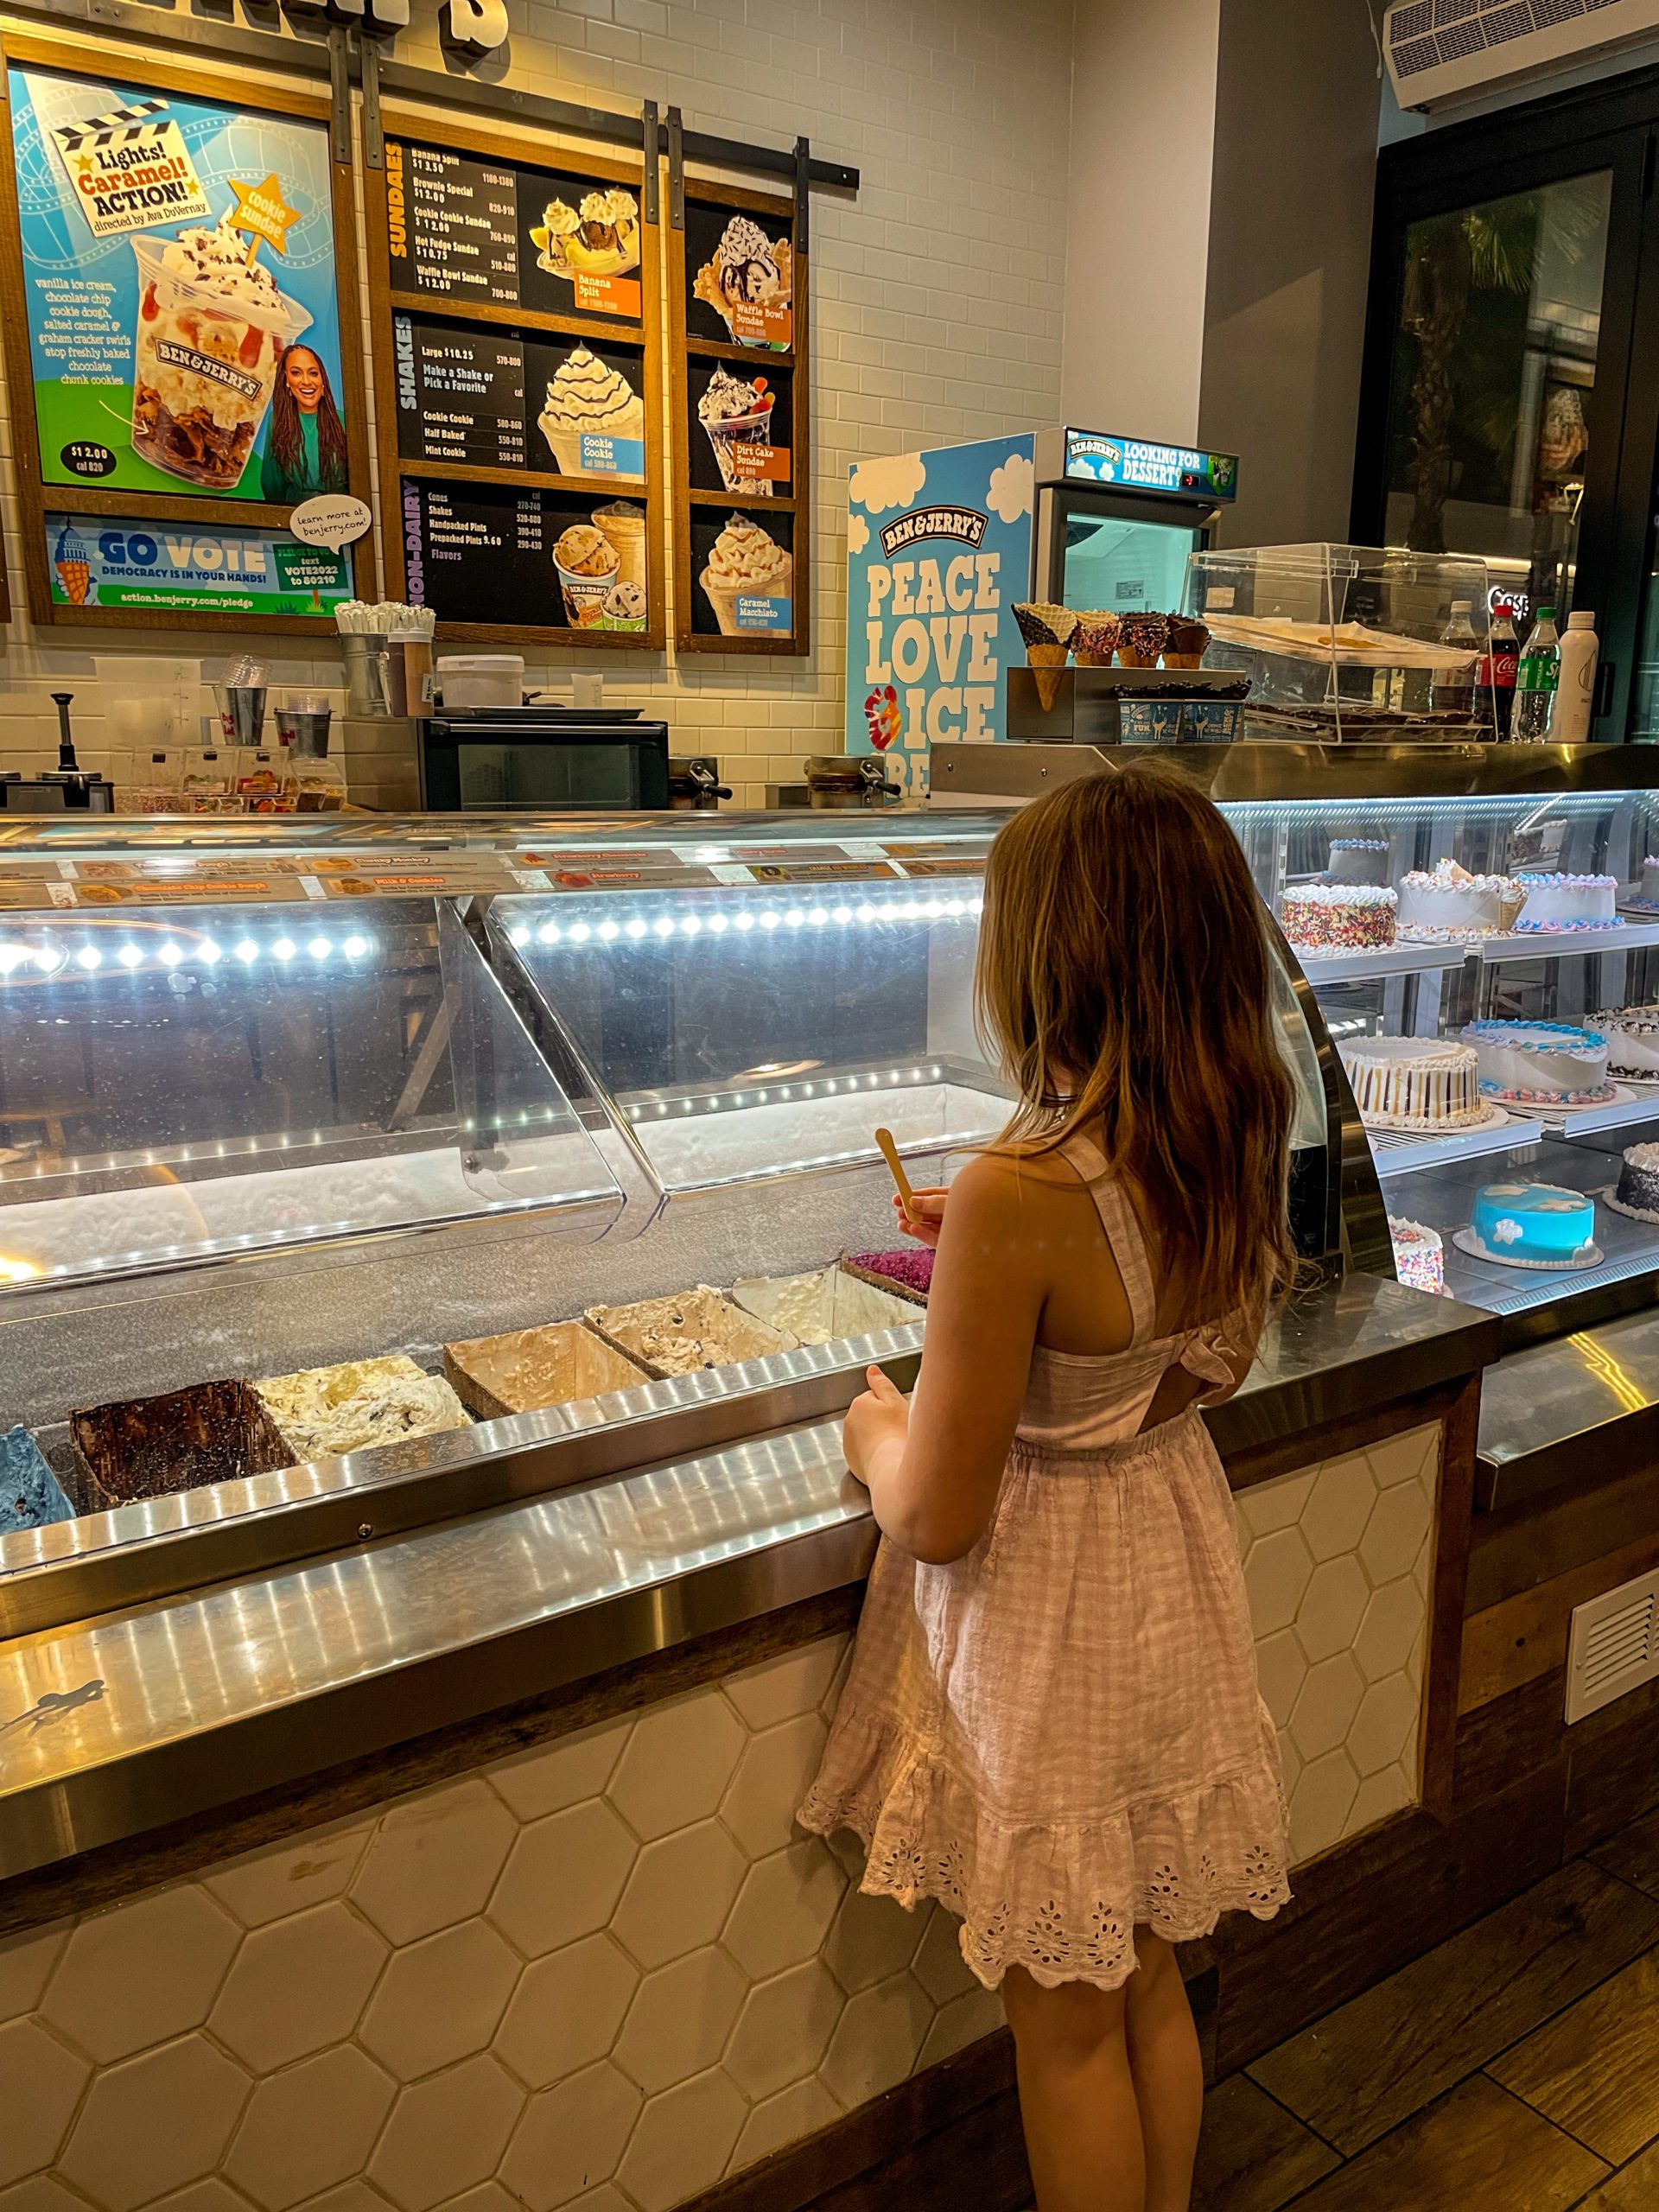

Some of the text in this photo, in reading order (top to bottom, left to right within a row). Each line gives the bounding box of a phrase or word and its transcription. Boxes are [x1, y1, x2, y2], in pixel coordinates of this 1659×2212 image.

[95, 141, 167, 170] Lights!
[411, 148, 460, 166] Banana Split
[78, 156, 188, 195] Caramel!
[482, 173, 514, 188] 1180-1380
[413, 177, 474, 198] Brownie Special
[92, 181, 188, 217] ACTION!
[385, 142, 407, 258] SUNDAES
[248, 191, 286, 224] cookie
[488, 202, 515, 216] 820-910
[94, 203, 207, 232] directed by Ava DuVernay
[239, 204, 283, 240] sundae
[414, 206, 492, 229] Cookie Cookie Sundae
[490, 231, 516, 245] 760-890
[415, 235, 480, 256] Hot Fudge Sundae
[506, 251, 516, 262] cal
[416, 264, 488, 286] Waffle Bowl Sundae
[578, 273, 612, 289] Banana
[35, 278, 117, 293] vanilla ice cream,
[578, 284, 600, 298] Split
[45, 291, 111, 307] chocolate chip
[492, 288, 518, 302] 700-800
[49, 306, 112, 320] cookie dough,
[736, 303, 785, 321] Waffle Bowl
[44, 319, 121, 332] salted caramel &
[736, 313, 765, 327] Sundae
[38, 333, 131, 346] graham cracker swirls
[45, 346, 130, 360] atop freshly baked
[422, 346, 442, 358] Large
[68, 360, 111, 372] chocolate
[395, 315, 417, 410] SHAKES
[496, 354, 522, 367] 570-800
[60, 373, 124, 385] chunk cookies
[423, 363, 494, 382] Make a Shake or
[423, 376, 487, 394] Pick a Favorite
[514, 388, 524, 398] cal
[423, 410, 474, 425] Cookie Cookie
[424, 428, 466, 441] Half Baked
[499, 435, 524, 447] 550-810
[583, 435, 613, 449] Cookie
[425, 445, 466, 458] Mint Cookie
[499, 451, 524, 463] 550-810
[583, 447, 613, 460] Cookie
[736, 445, 774, 458] Dirt Cake
[1124, 442, 1201, 469] LOOKING FOR
[76, 461, 104, 473] cal 820
[736, 454, 766, 467] Sundae
[1122, 459, 1183, 487] DESSERT?
[428, 492, 448, 502] Cones
[297, 517, 323, 525] learn
[354, 506, 364, 516] at
[429, 505, 453, 516] Shakes
[303, 518, 367, 537] benjerry.com!
[429, 518, 487, 532] Handpacked Pints
[517, 526, 542, 537] 390-410
[885, 512, 982, 550] BEN&JERRY'S
[404, 480, 425, 608] NON-DAIRY
[429, 532, 465, 543] Prepacked
[465, 535, 482, 545] Pints
[99, 532, 266, 573] GO VOTE
[431, 548, 462, 561] Flavors
[301, 556, 320, 565] text
[102, 566, 267, 584] DEMOCRACY IS IN YOUR HANDS!
[284, 565, 339, 576] VOTE2022
[290, 575, 336, 586] to 80210
[867, 552, 1001, 618] PEACE
[121, 593, 253, 609] action.benjerry.com/pledge
[739, 597, 771, 608] Caramel
[740, 607, 779, 618] Macchiato
[865, 613, 999, 685] LOVE
[903, 686, 995, 750] ICE
